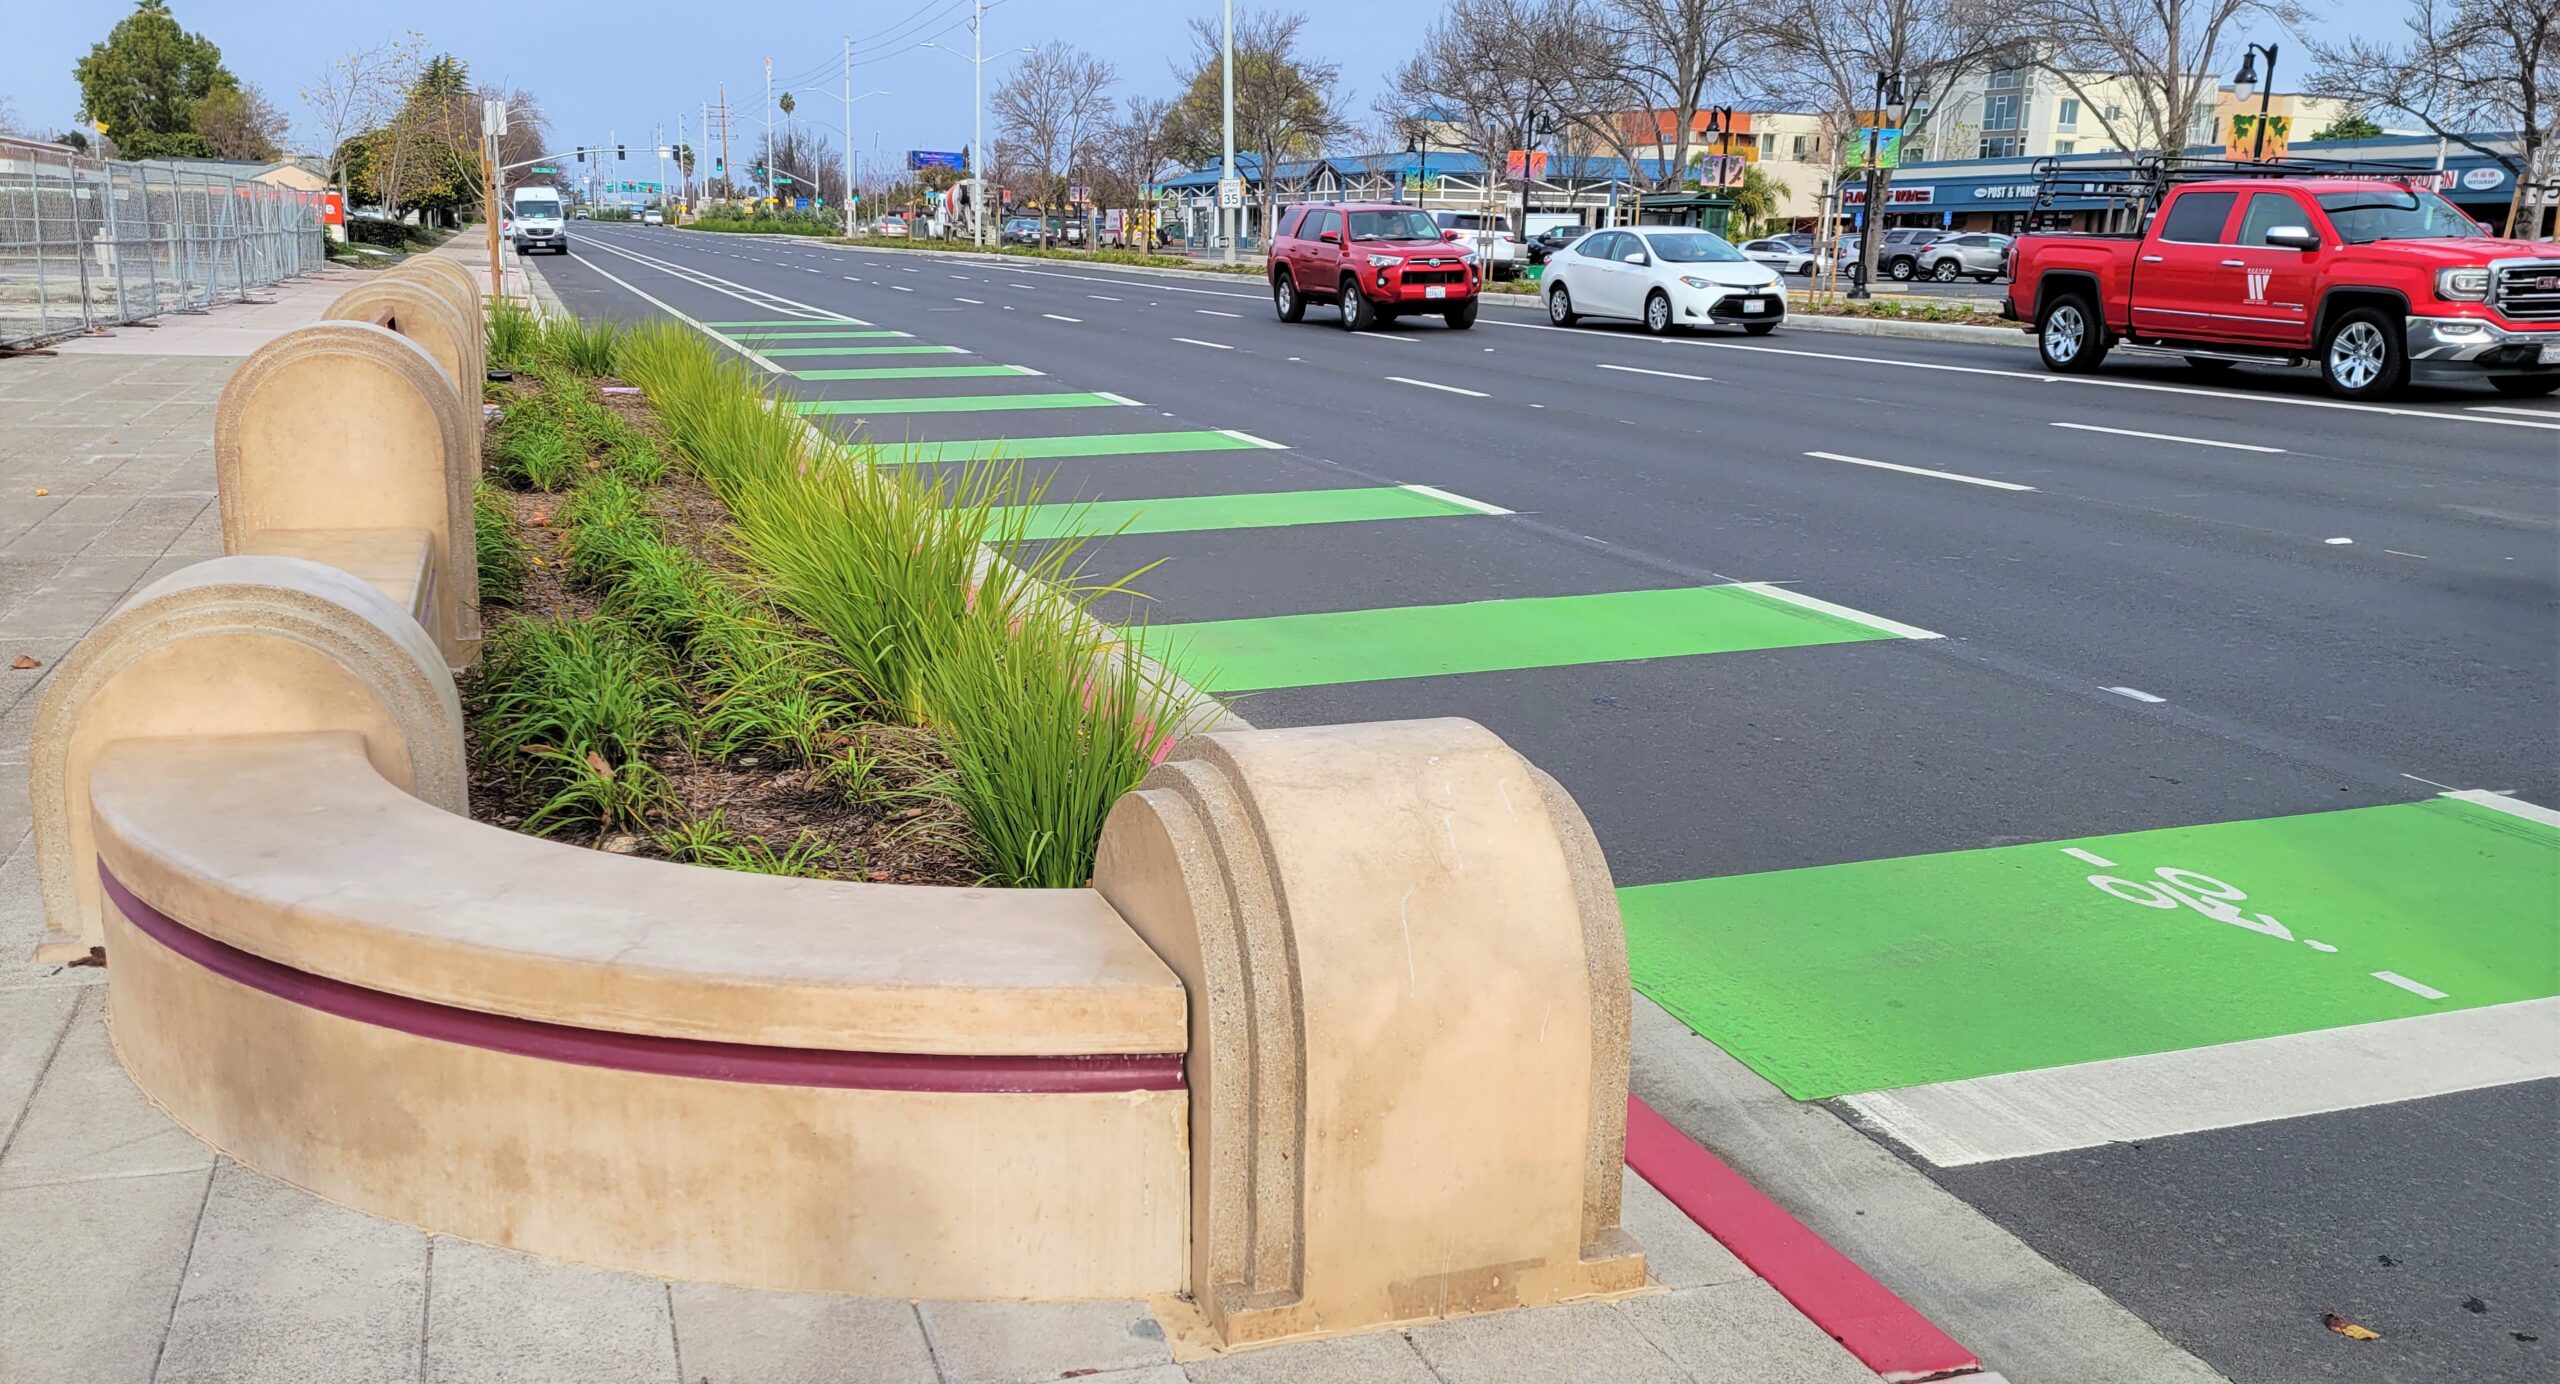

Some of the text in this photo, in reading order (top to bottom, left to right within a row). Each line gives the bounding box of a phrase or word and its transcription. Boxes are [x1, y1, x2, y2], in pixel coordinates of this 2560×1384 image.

[1986, 186, 2007, 199] POST
[2007, 186, 2015, 197] &
[1223, 194, 1239, 205] 35
